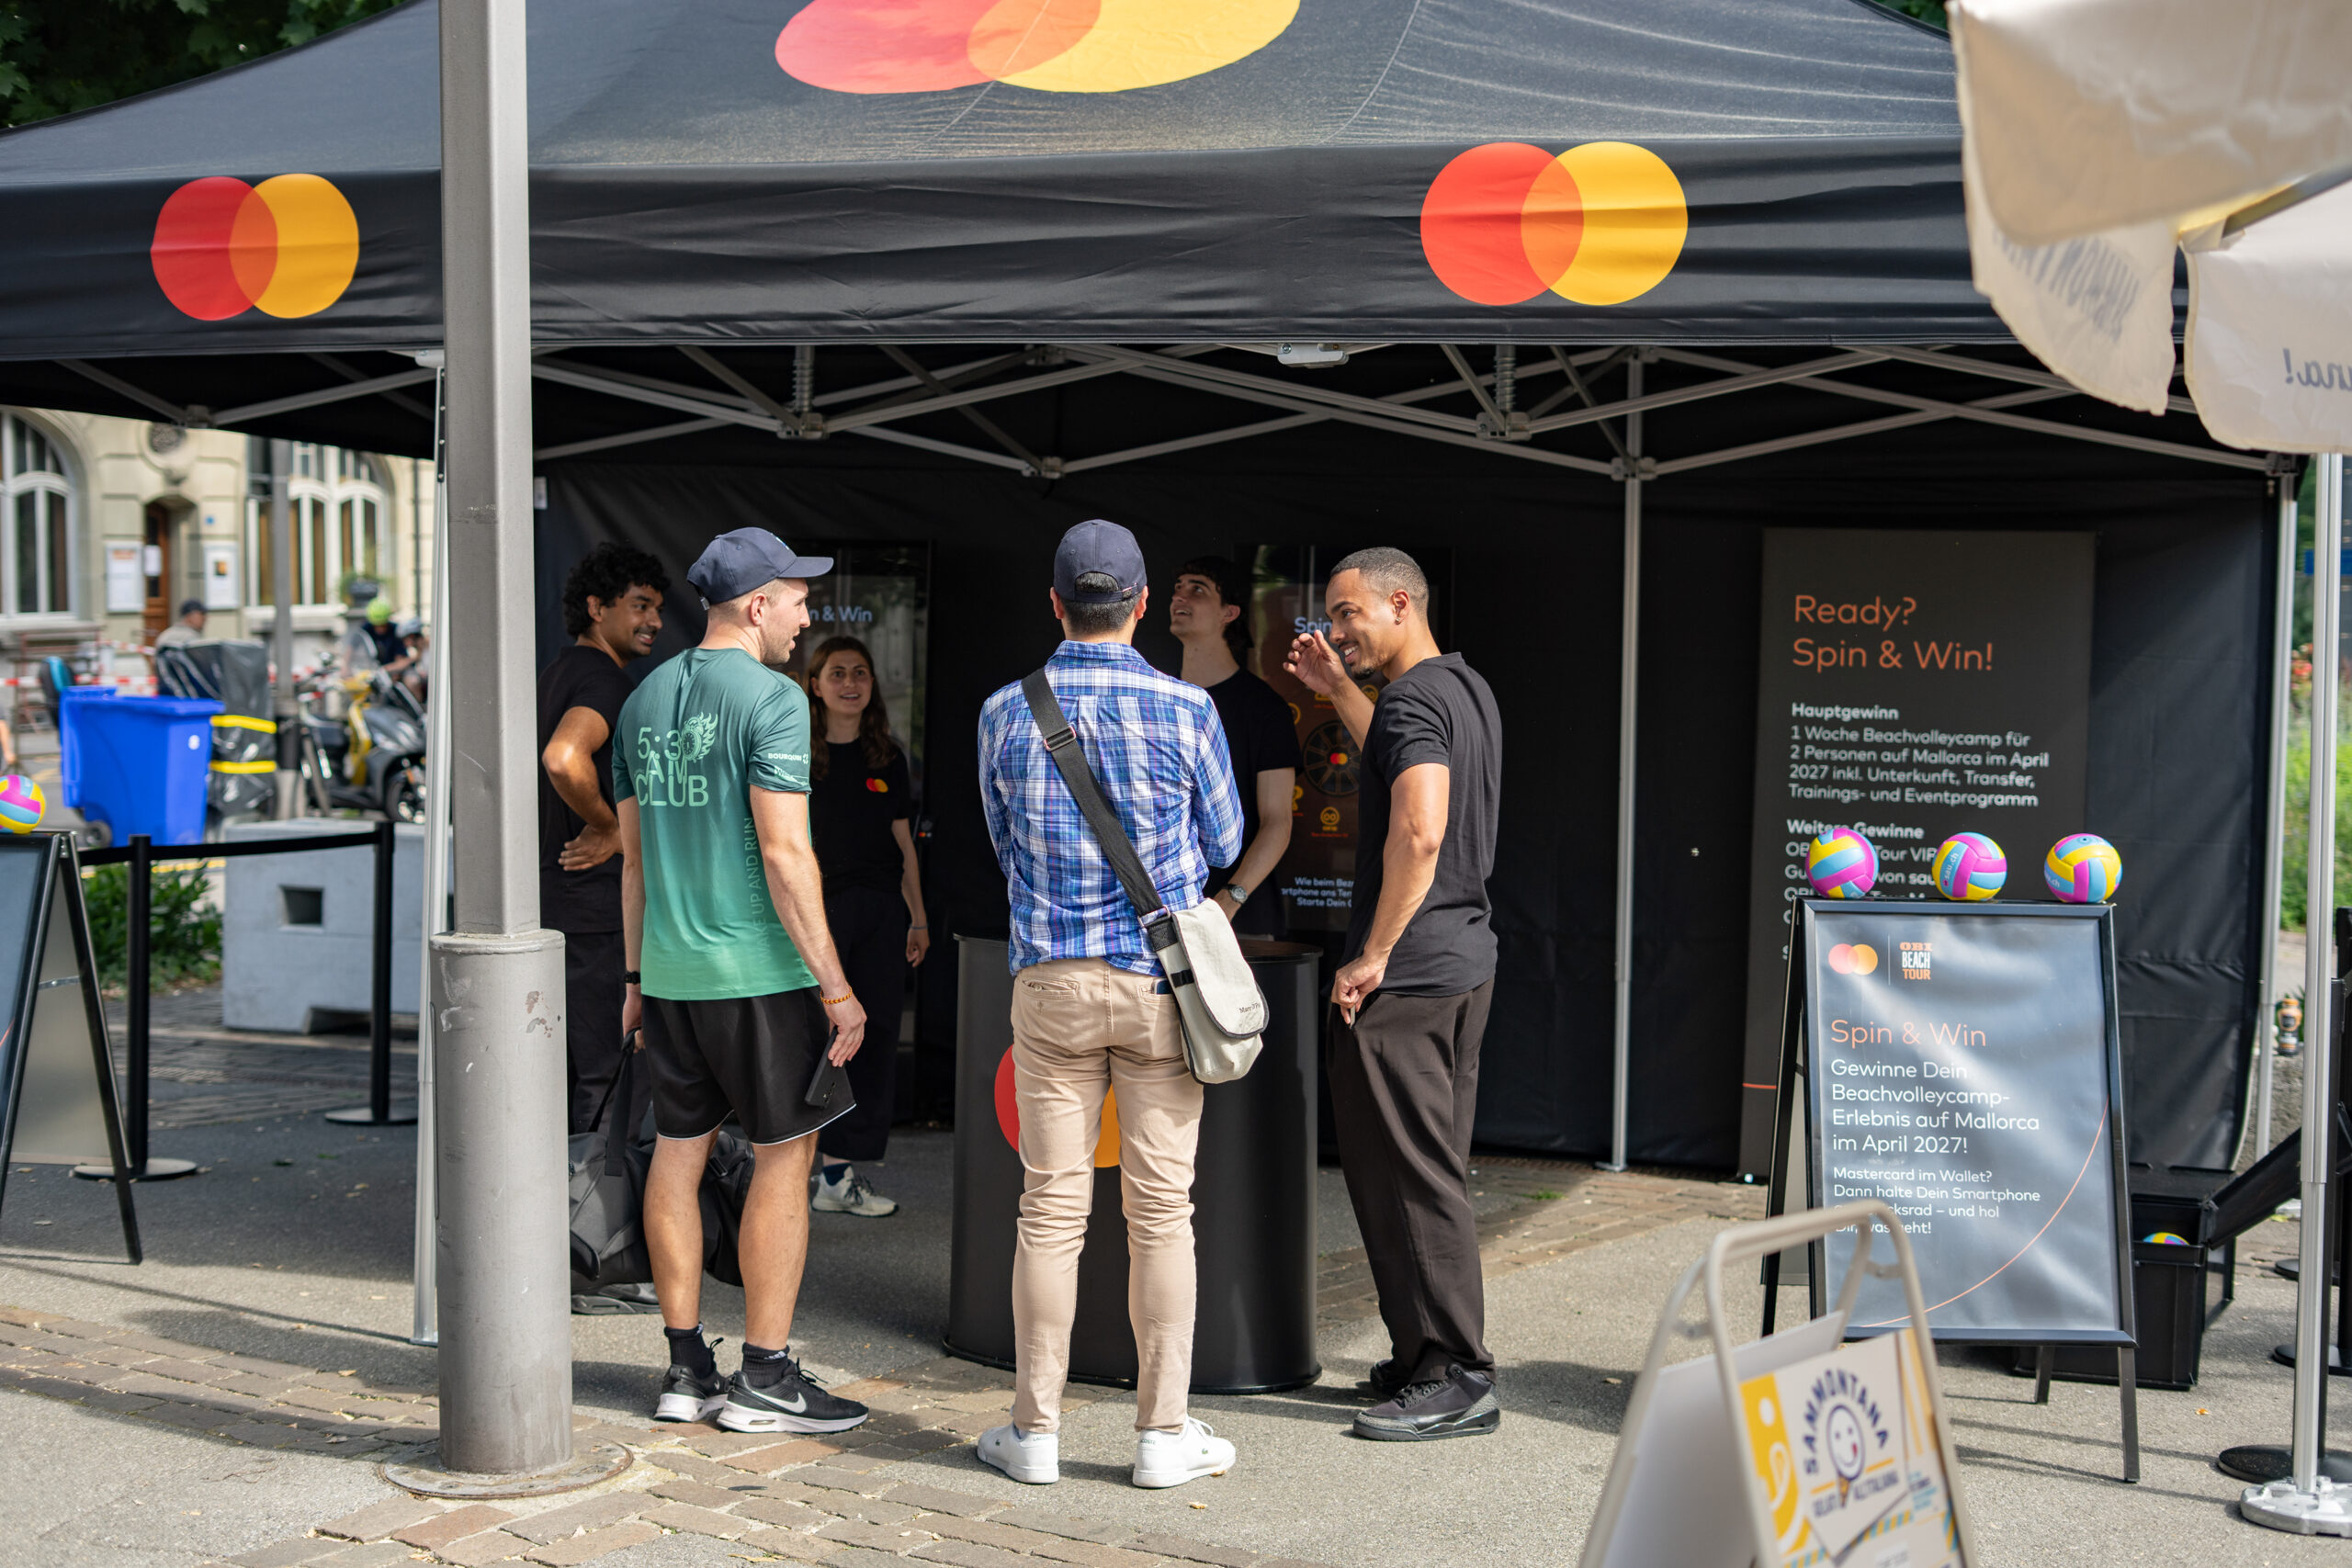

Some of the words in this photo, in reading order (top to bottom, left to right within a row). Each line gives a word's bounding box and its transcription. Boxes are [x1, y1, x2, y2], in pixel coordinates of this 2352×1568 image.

[822, 605, 836, 623] &
[838, 605, 873, 623] Win
[1794, 594, 1917, 631] Ready?
[1792, 637, 1867, 672] Spin
[1879, 640, 1903, 669] &
[1914, 640, 1993, 671] Win!
[1792, 702, 1899, 721] Hauptgewinn
[1791, 725, 1801, 739] 1
[1804, 726, 1860, 742] Woche
[1863, 728, 2002, 748] Beachvolleycamp
[2006, 731, 2031, 747] für
[646, 750, 689, 784] AM
[1790, 745, 1801, 760] 2
[1804, 745, 1876, 761] Personen
[1881, 747, 1909, 763] auf
[1913, 749, 1982, 765] Mallorca
[1985, 750, 2007, 767] im
[2010, 751, 2049, 771] April
[1790, 765, 1829, 780] 2027
[1833, 765, 1863, 781] inkl.
[1867, 767, 1961, 787] Unterkunft,
[1963, 770, 2035, 789] Transfer,
[635, 774, 709, 807] CLUB
[1789, 784, 1865, 804] Trainings-
[1871, 787, 1900, 803] und
[1905, 788, 2038, 809] Eventprogramm
[743, 817, 759, 852] RUN
[1853, 822, 1925, 840] Gewinne
[1875, 845, 1907, 862] Tour
[744, 858, 763, 890] AND
[1945, 852, 1960, 881] sau.ch
[1295, 876, 1312, 886] Wie
[1313, 877, 1335, 886] beim
[750, 893, 765, 914] UP
[1296, 897, 1325, 906] Starte
[1327, 898, 1346, 907] Dein
[1320, 889, 1336, 897] ans
[752, 918, 773, 964] WAKE
[1899, 942, 1932, 952] OBI
[1901, 951, 1931, 969] BEACH
[1902, 968, 1931, 981] TOUR
[1831, 1019, 1893, 1049] Spin
[1902, 1021, 1921, 1045] &
[1929, 1022, 1986, 1047] Win
[1831, 1059, 1917, 1078] Gewinne
[1924, 1062, 1968, 1079] Dein
[1832, 1083, 2010, 1109] Beachvolleycamp-
[1833, 1109, 1911, 1128] Erlebnis
[1916, 1111, 1950, 1129] auf
[1955, 1112, 2040, 1131] Mallorca
[1833, 1134, 1857, 1151] im
[1862, 1134, 1908, 1157] April
[1914, 1136, 1968, 1154] 2027!
[1833, 1167, 1916, 1181] Mastercard
[1918, 1168, 1936, 1181] im
[1939, 1168, 1992, 1183] Wallet?
[1834, 1184, 1872, 1198] Dann
[1876, 1185, 1913, 1199] halte
[1917, 1187, 1949, 1200] Dein
[1952, 1187, 2041, 1202] Smartphone
[1949, 1204, 1975, 1217] und
[1979, 1205, 1999, 1218] hol
